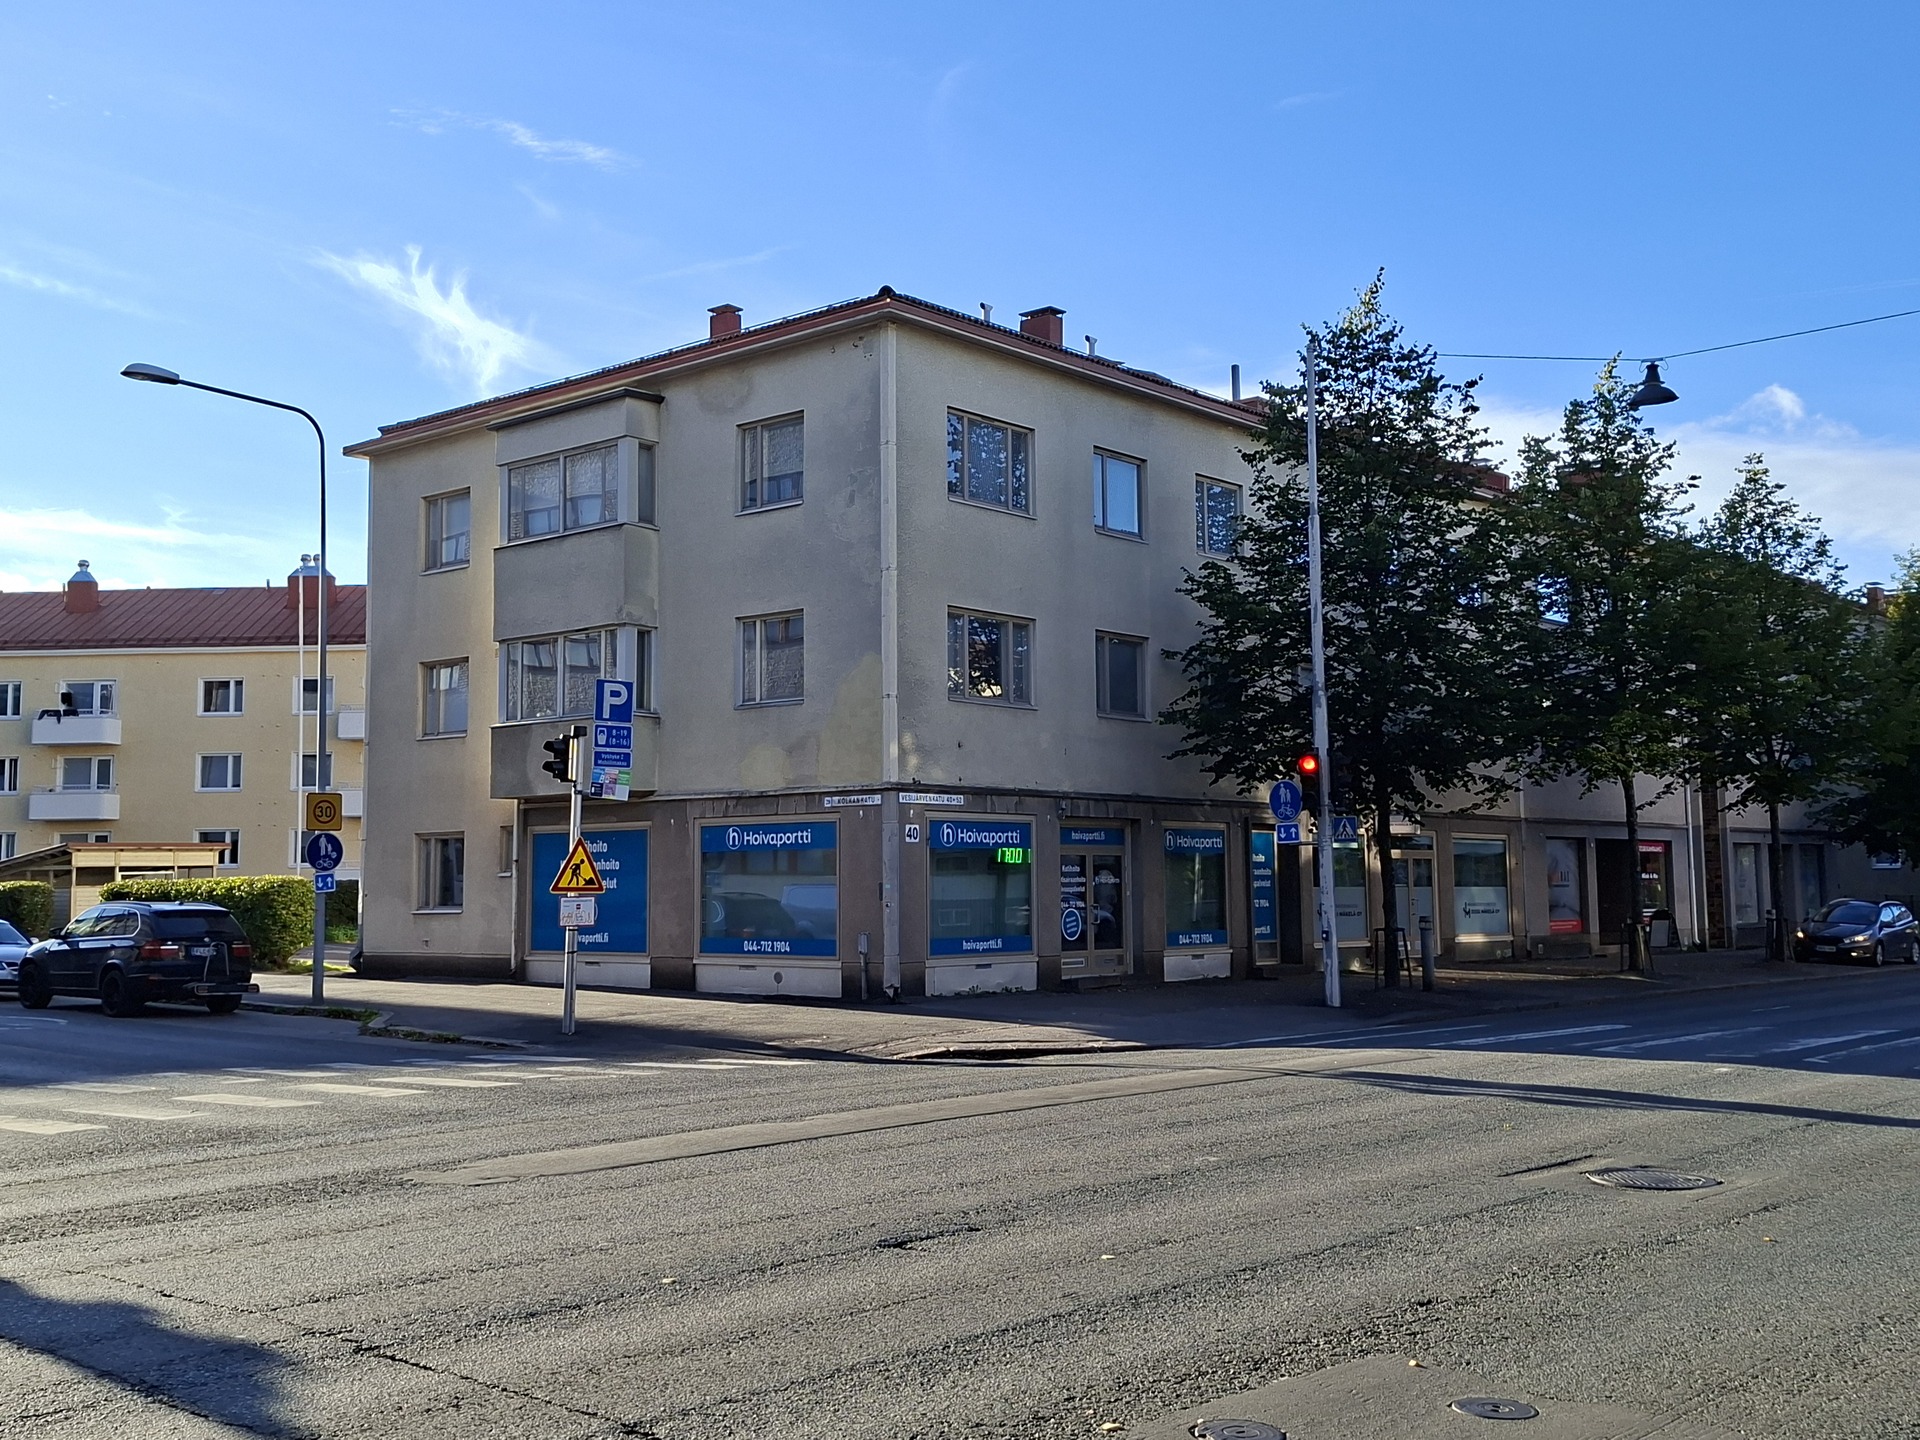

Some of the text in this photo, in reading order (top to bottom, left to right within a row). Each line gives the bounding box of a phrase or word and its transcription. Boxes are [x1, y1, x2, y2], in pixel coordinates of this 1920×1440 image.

[603, 682, 628, 718] P
[317, 805, 332, 818] 30
[743, 829, 811, 848] Hoivaportti
[906, 827, 918, 840] 40
[958, 829, 1020, 846] Hoivaportti
[1177, 836, 1223, 850] Hoivaportti
[743, 940, 790, 952] 044-712 1904
[962, 938, 1002, 952] hoivaportti.fi
